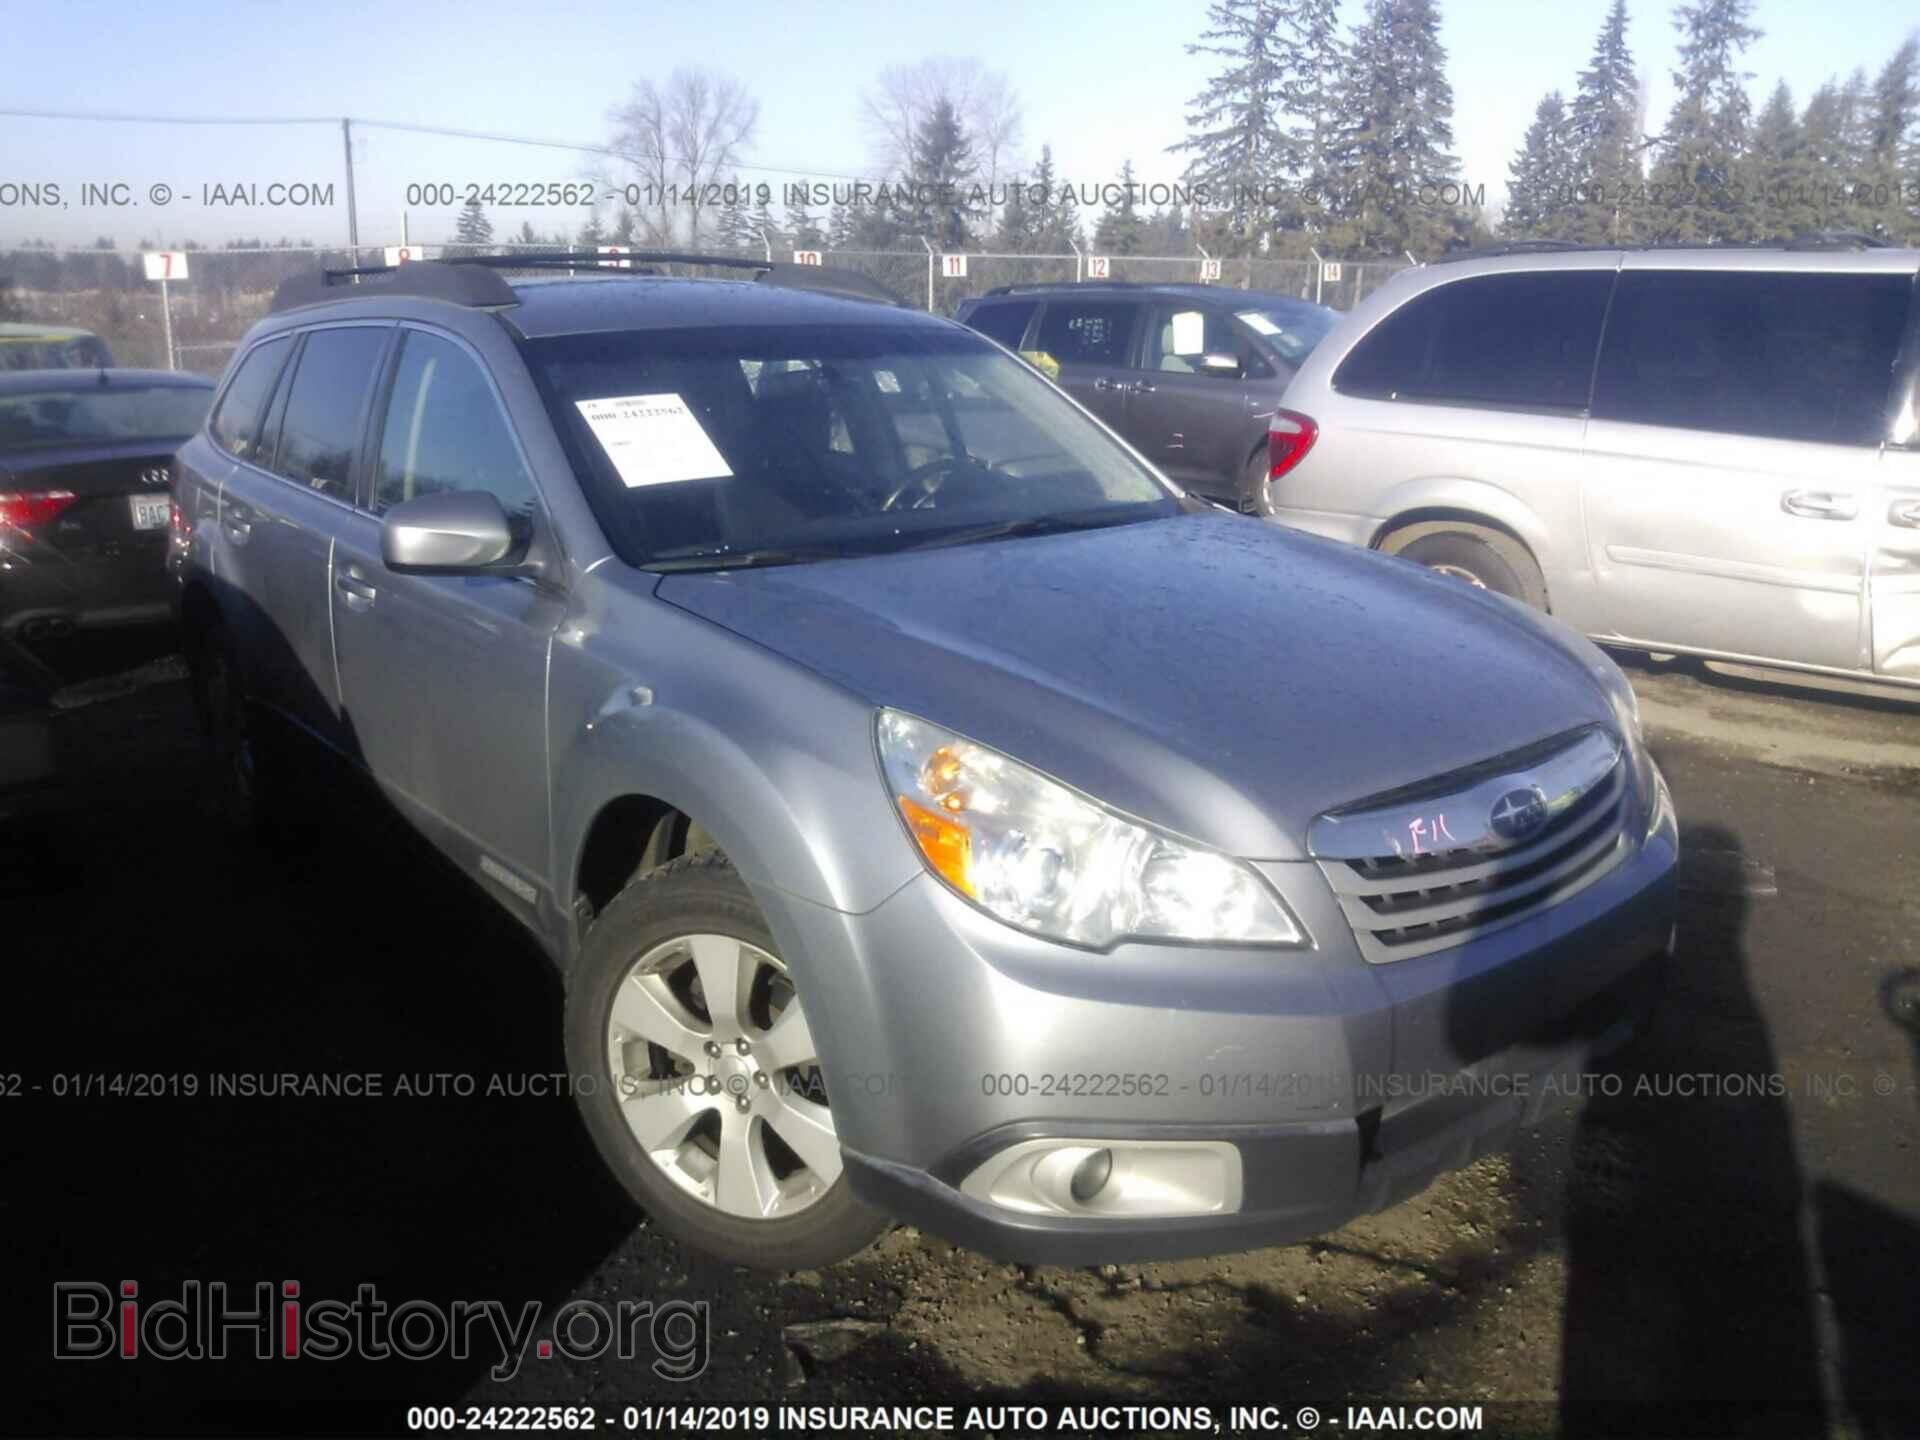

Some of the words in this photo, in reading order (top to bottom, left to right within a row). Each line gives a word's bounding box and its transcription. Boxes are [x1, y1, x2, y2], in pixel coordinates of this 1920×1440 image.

[160, 254, 172, 278] 7
[949, 258, 960, 275] 11
[1092, 259, 1106, 276] 12
[1205, 261, 1218, 278] 13
